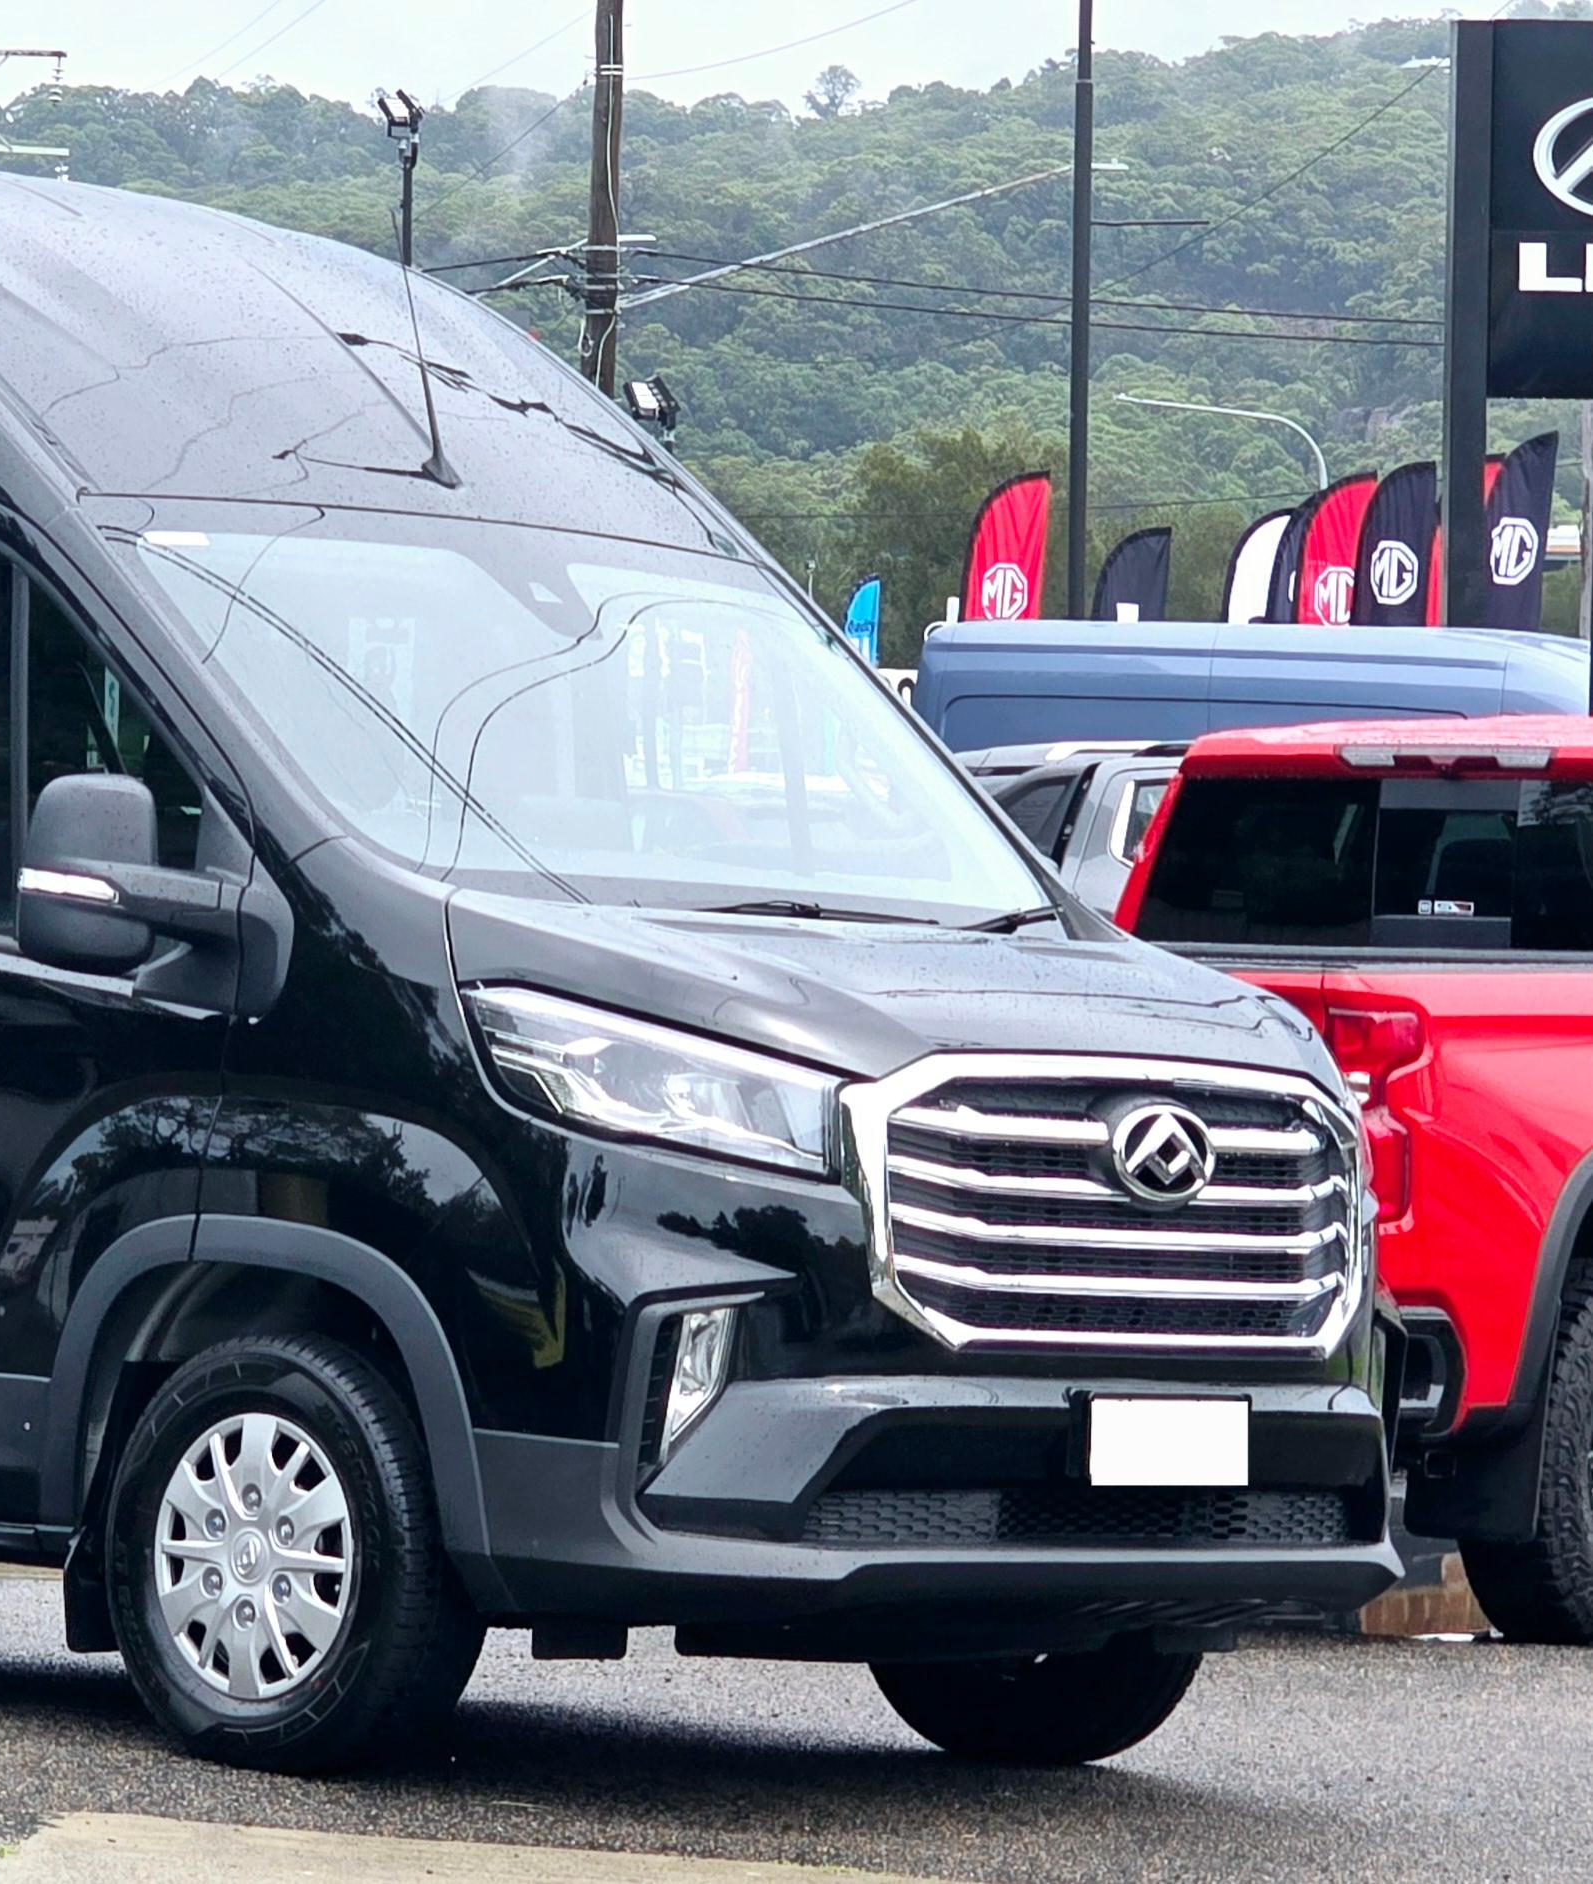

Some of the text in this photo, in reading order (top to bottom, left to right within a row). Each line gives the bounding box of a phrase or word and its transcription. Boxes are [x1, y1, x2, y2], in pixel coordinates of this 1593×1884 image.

[1518, 242, 1593, 292] L
[1372, 545, 1415, 600] MG
[1491, 523, 1534, 580] MG
[982, 566, 1026, 619] MG
